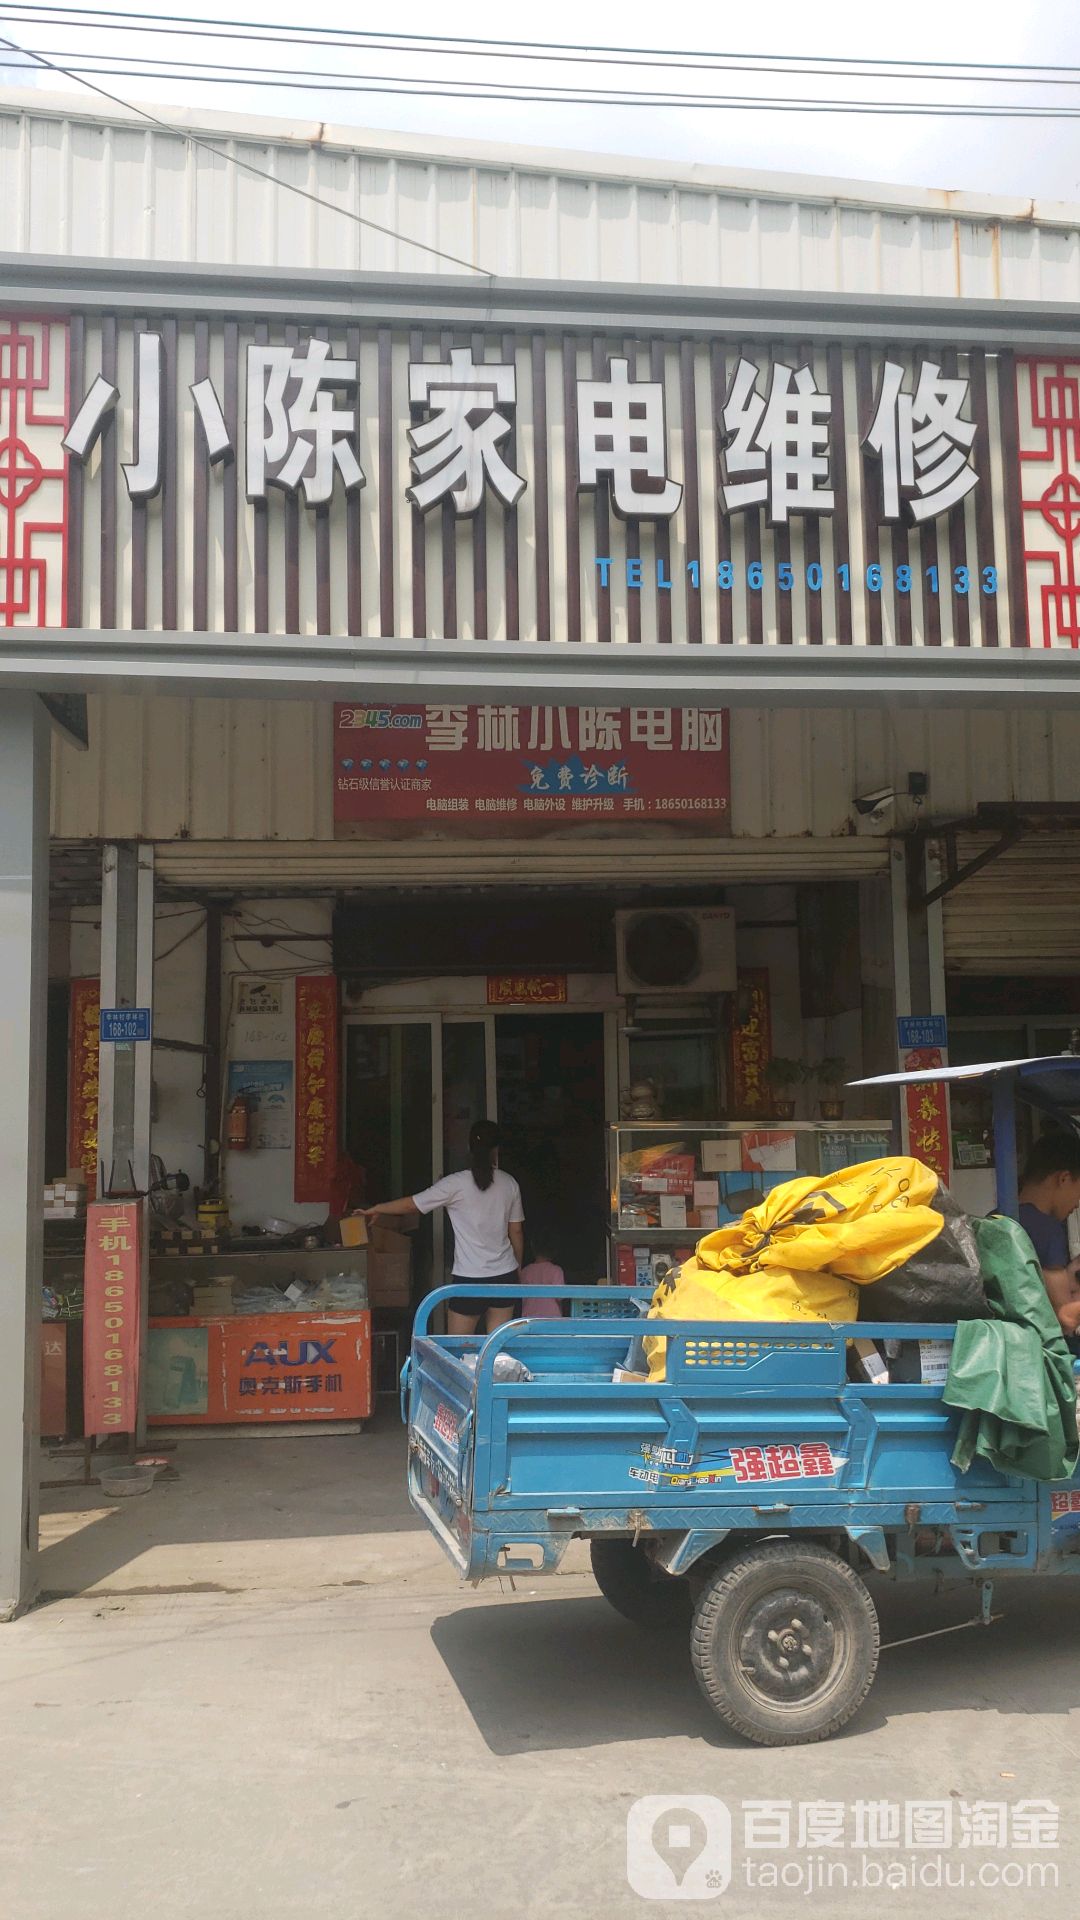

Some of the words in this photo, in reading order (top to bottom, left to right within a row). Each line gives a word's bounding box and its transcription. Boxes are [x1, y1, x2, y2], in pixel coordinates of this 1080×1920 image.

[61, 331, 981, 526] 小陈家电维修
[339, 709, 423, 729] 2345.com
[337, 778, 432, 791] 钻石级信誉认证商家
[530, 763, 629, 791] 免费诊断
[426, 798, 469, 811] 电脑组装
[475, 798, 517, 811] 电脑维修
[523, 798, 565, 811] 电脑外设
[571, 798, 614, 811] 维护升级
[109, 1022, 137, 1037] 168-102
[97, 1217, 131, 1425] 手机18650168133
[243, 1338, 337, 1367] AUX
[239, 1374, 342, 1396] 奥克斯手机
[730, 1442, 836, 1483] 强超鑫
